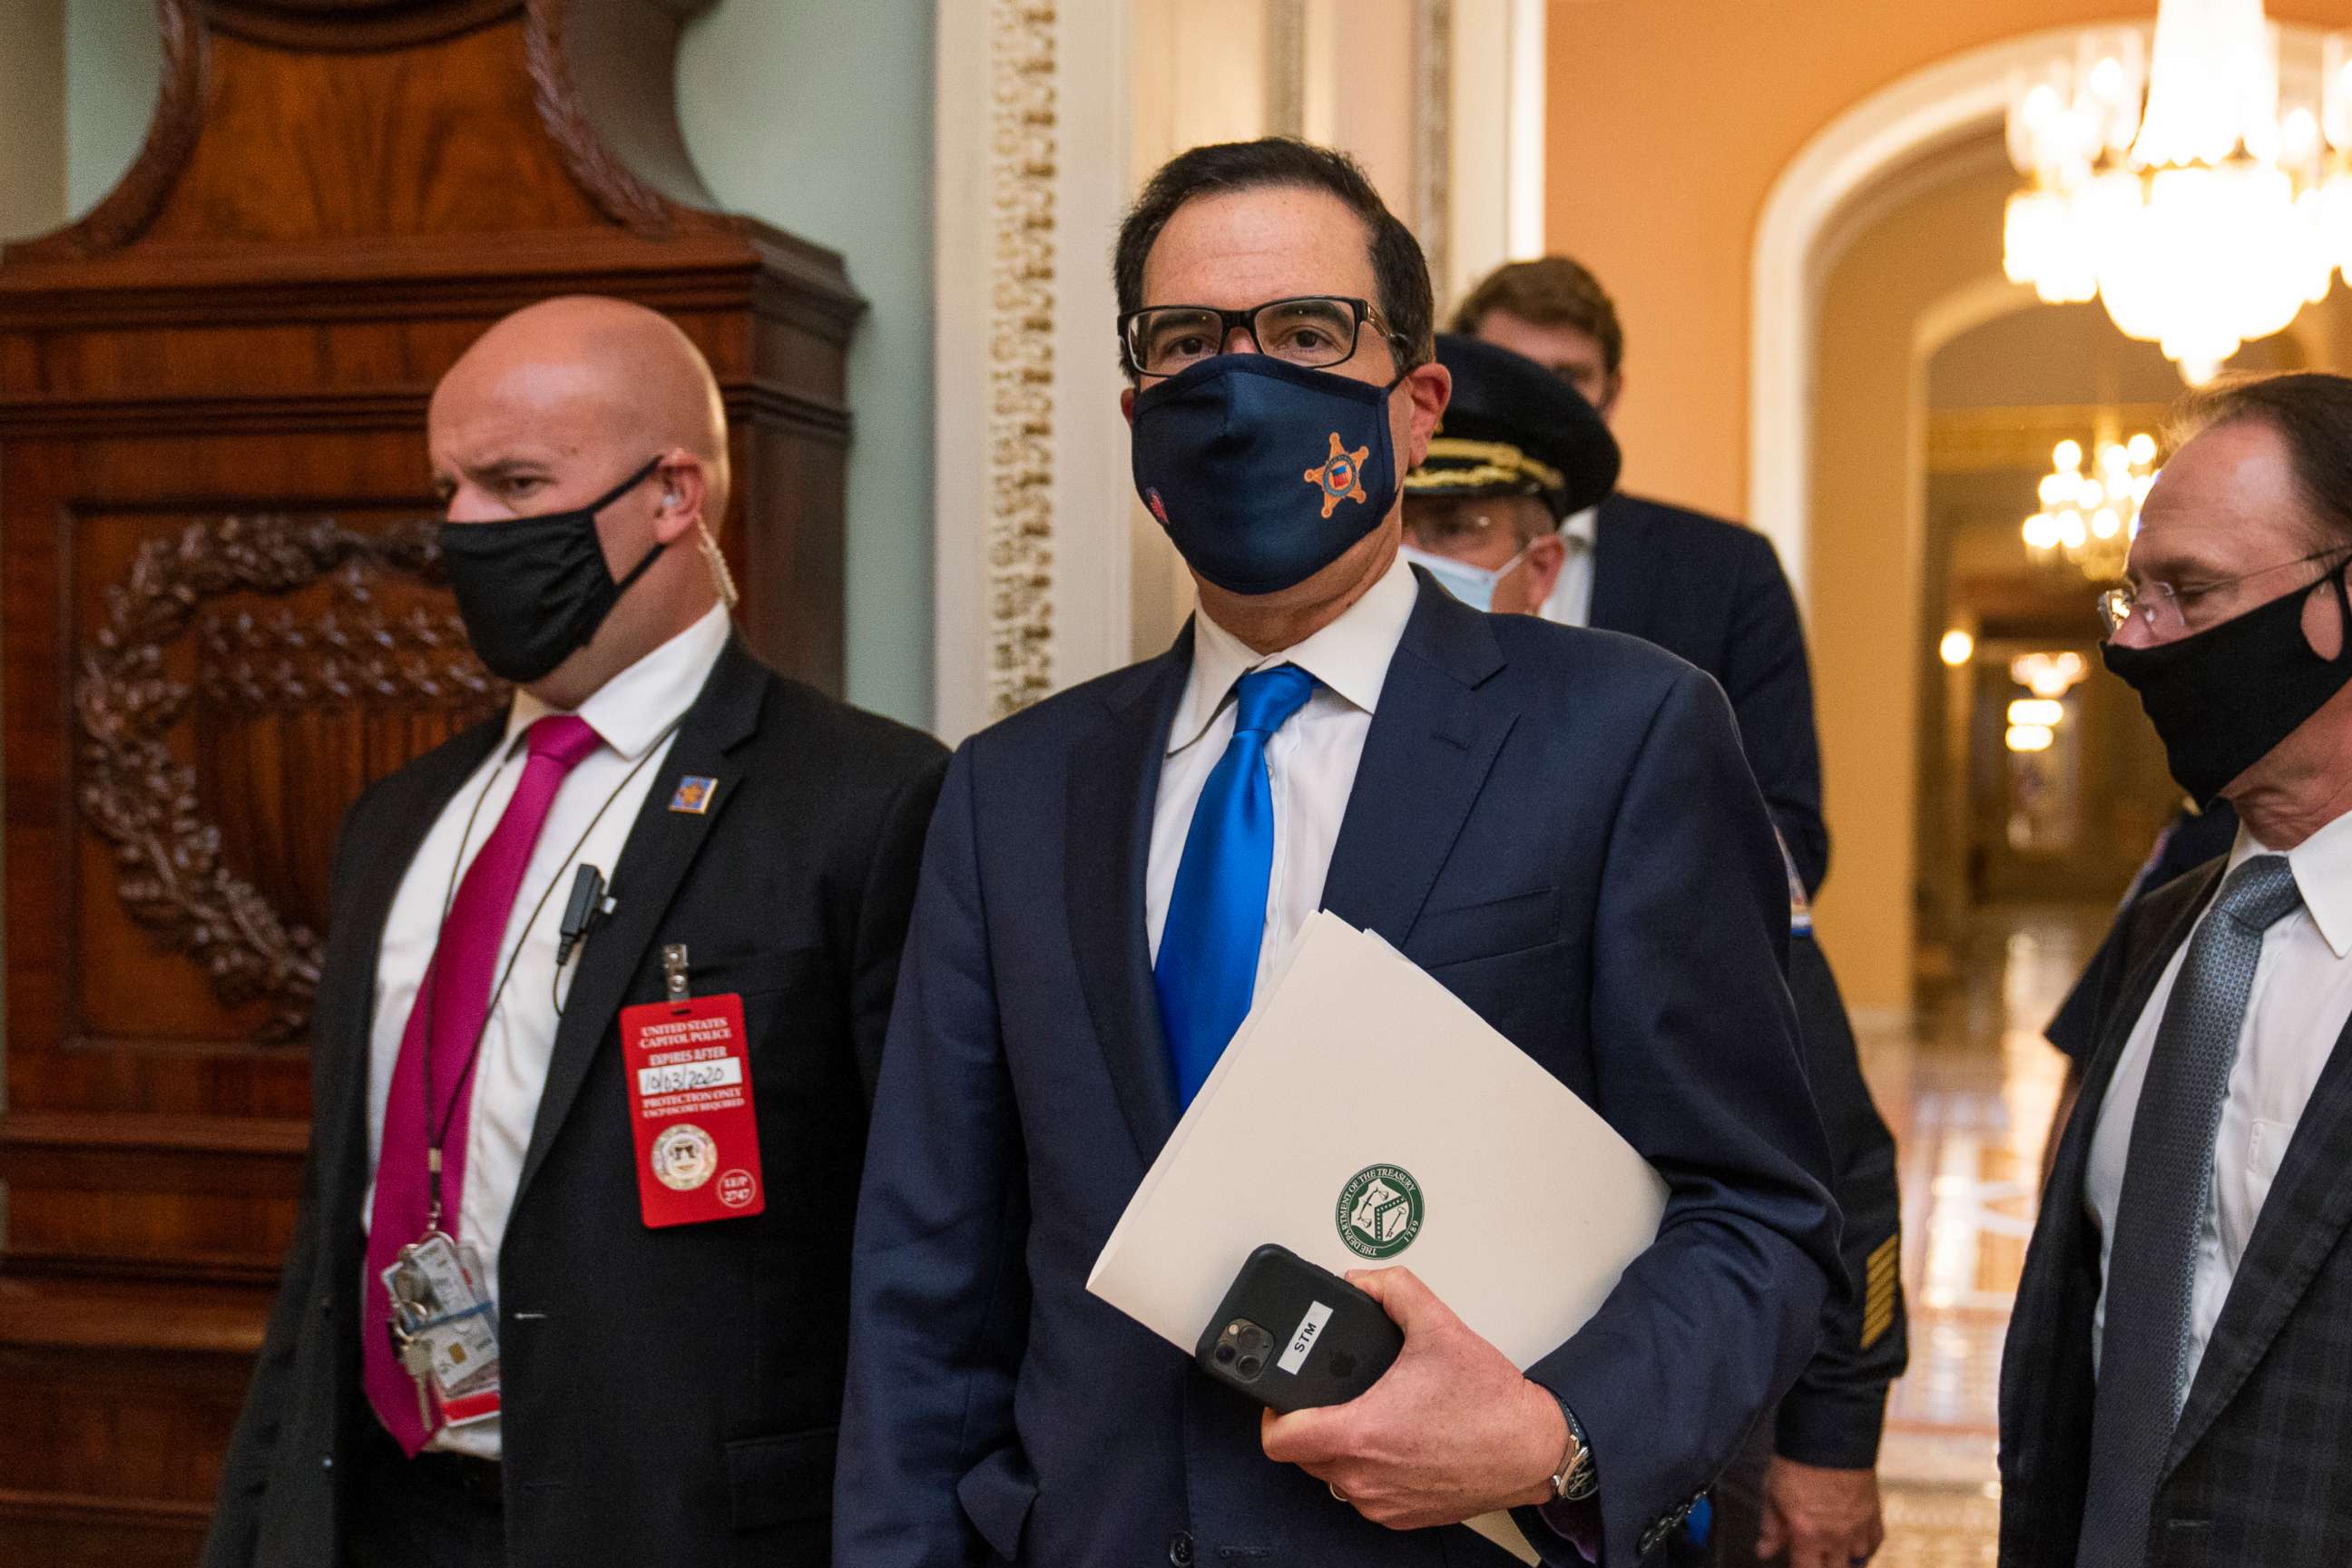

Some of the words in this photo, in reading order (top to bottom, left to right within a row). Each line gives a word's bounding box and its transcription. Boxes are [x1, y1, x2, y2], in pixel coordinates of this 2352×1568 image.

[642, 1023, 686, 1036] UNITED
[687, 1017, 728, 1030] STATES
[639, 1034, 688, 1048] CAPITOL
[690, 1027, 731, 1043] POLICE
[650, 1050, 692, 1066] EXPIRES
[693, 1045, 727, 1060] AFTER
[644, 1063, 725, 1092] 10/03/2020
[642, 1092, 712, 1108] PROTECTION
[712, 1087, 741, 1100] ONLY
[699, 1098, 745, 1112] REQUIRED
[1348, 1180, 1359, 1193] OF
[1358, 1168, 1377, 1184] THE
[1377, 1168, 1416, 1191] TREASURY
[1339, 1190, 1361, 1250] DEPARTMENT
[1403, 1220, 1419, 1243] 1789
[1360, 1243, 1377, 1256] THE
[1294, 1322, 1318, 1353] STM
